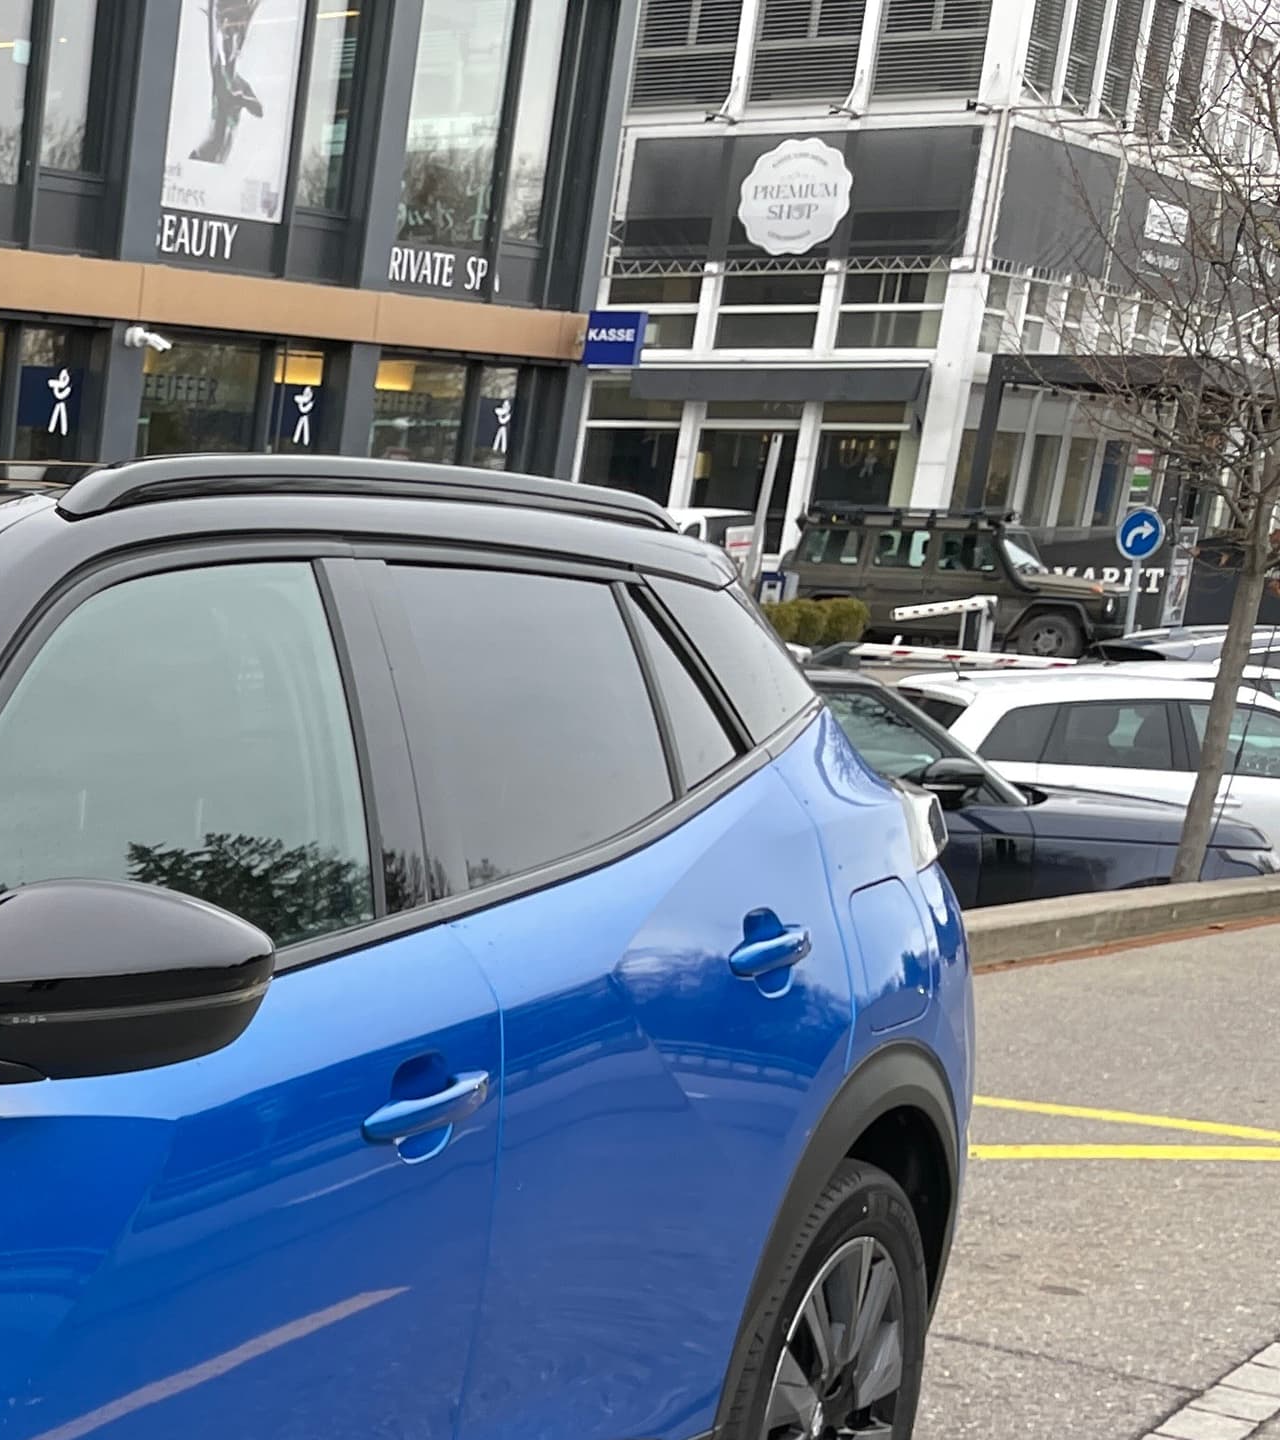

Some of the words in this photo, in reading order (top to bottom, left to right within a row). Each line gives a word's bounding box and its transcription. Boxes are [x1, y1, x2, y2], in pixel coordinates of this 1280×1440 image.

[753, 183, 838, 201] PREMIUM
[155, 213, 239, 260] EAUTY
[464, 256, 500, 292] SP
[588, 327, 636, 342] KASSE
